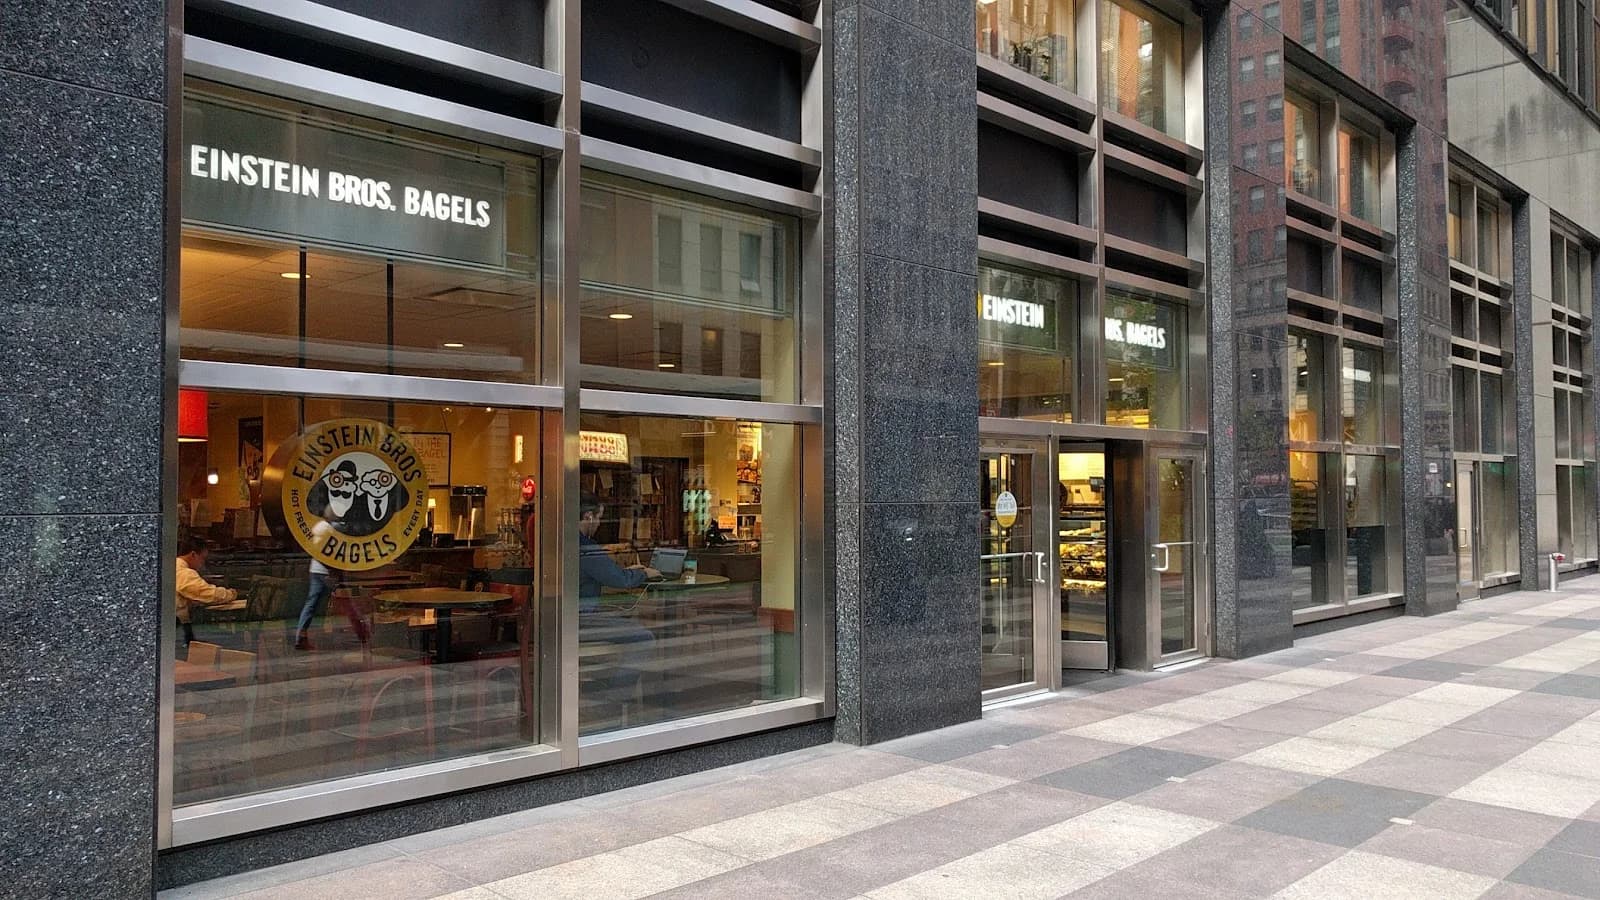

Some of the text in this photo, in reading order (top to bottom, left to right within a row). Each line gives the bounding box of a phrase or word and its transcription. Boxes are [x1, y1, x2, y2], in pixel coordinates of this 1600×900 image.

[190, 144, 491, 228] EINSTEIN BROS. BAGELS
[982, 294, 1045, 329] EINSTEIN
[1126, 321, 1166, 349] BAGELS
[292, 424, 422, 482] EINSTEIN BROS
[291, 488, 314, 540] HOT FRESH
[403, 489, 424, 537] EVERY DAY
[321, 534, 398, 564] BAGELS
